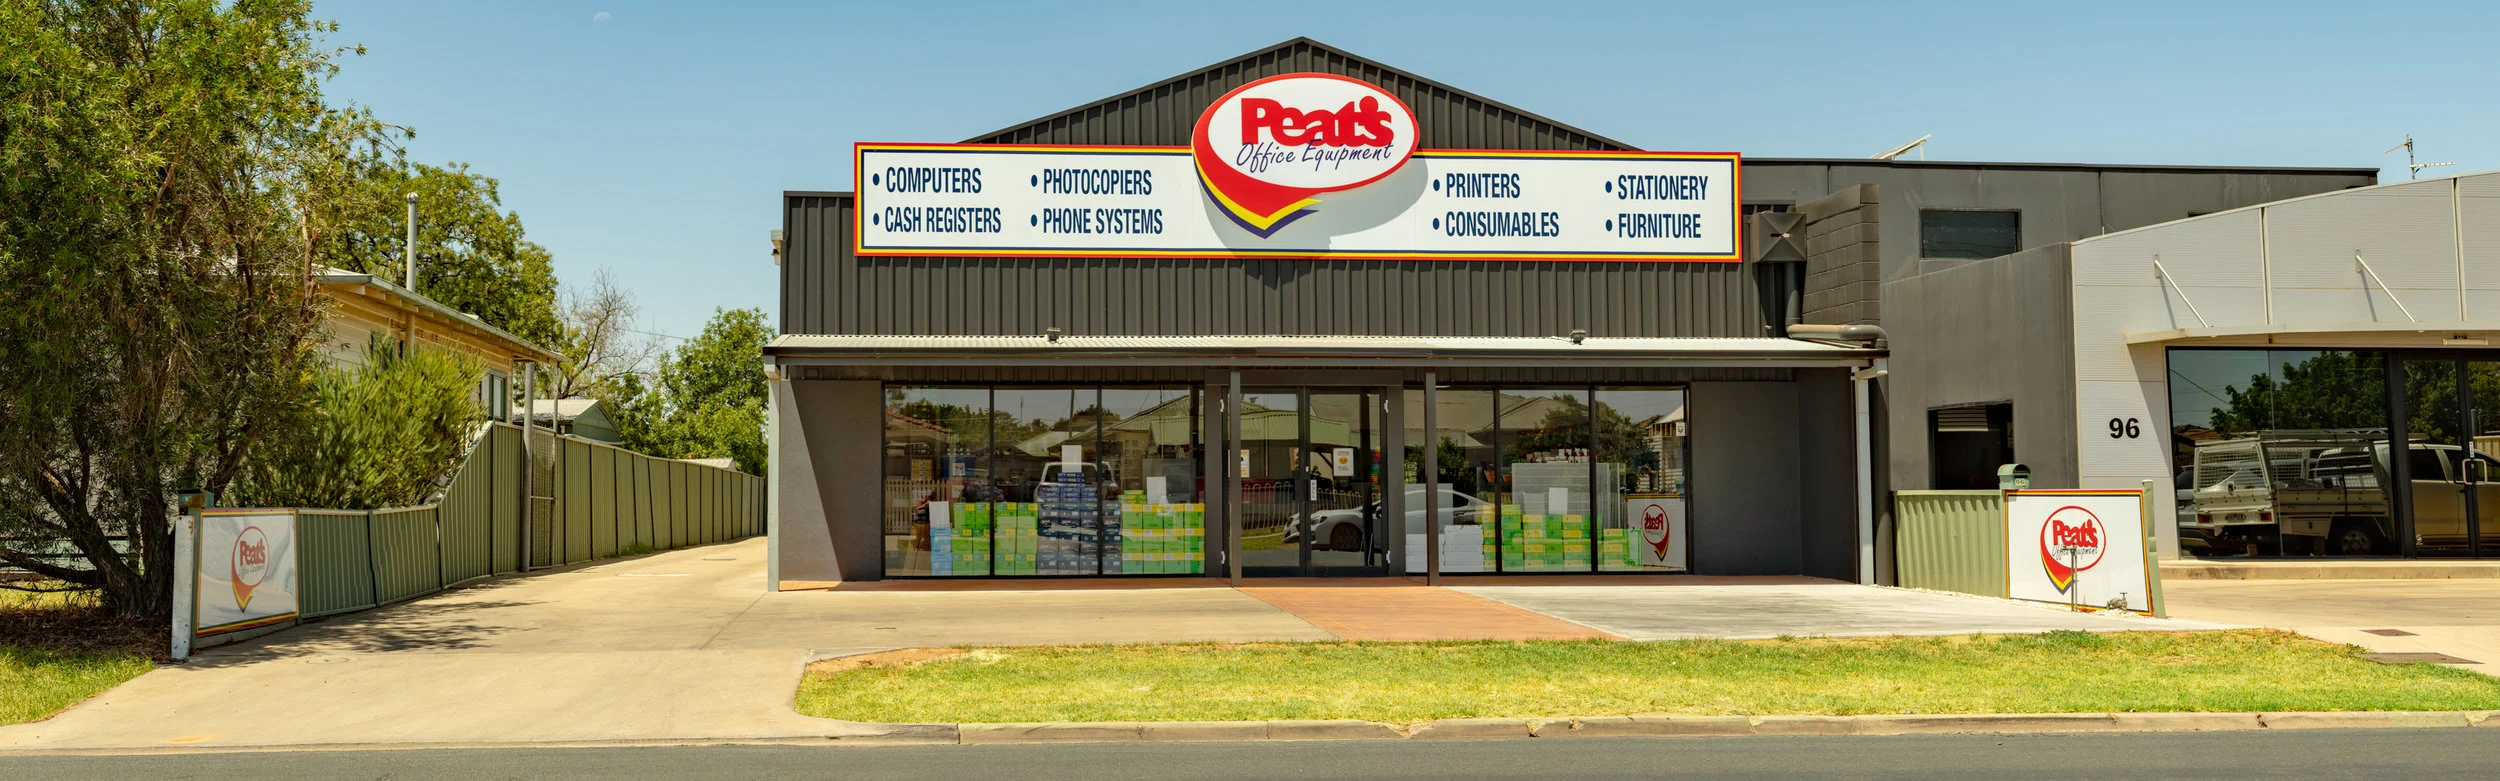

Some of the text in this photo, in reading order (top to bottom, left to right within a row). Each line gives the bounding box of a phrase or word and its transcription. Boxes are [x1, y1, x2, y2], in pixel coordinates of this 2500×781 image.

[1241, 95, 1395, 147] Peat's
[1236, 138, 1395, 174] Office Equipment
[886, 166, 982, 194] COMPUTERS
[1043, 168, 1152, 196] PHOTOCOPIERS
[1446, 172, 1521, 199] PRINTERS
[1617, 174, 1709, 201] STATIONERY
[885, 206, 1002, 234] CASH REGISTERS
[1043, 207, 1163, 235] PHONE SYSTEMS
[1445, 211, 1560, 238] CONSUMABLES
[1618, 213, 1702, 239] FURNITURE
[2108, 417, 2141, 440] 96
[2052, 518, 2098, 548] Peat's
